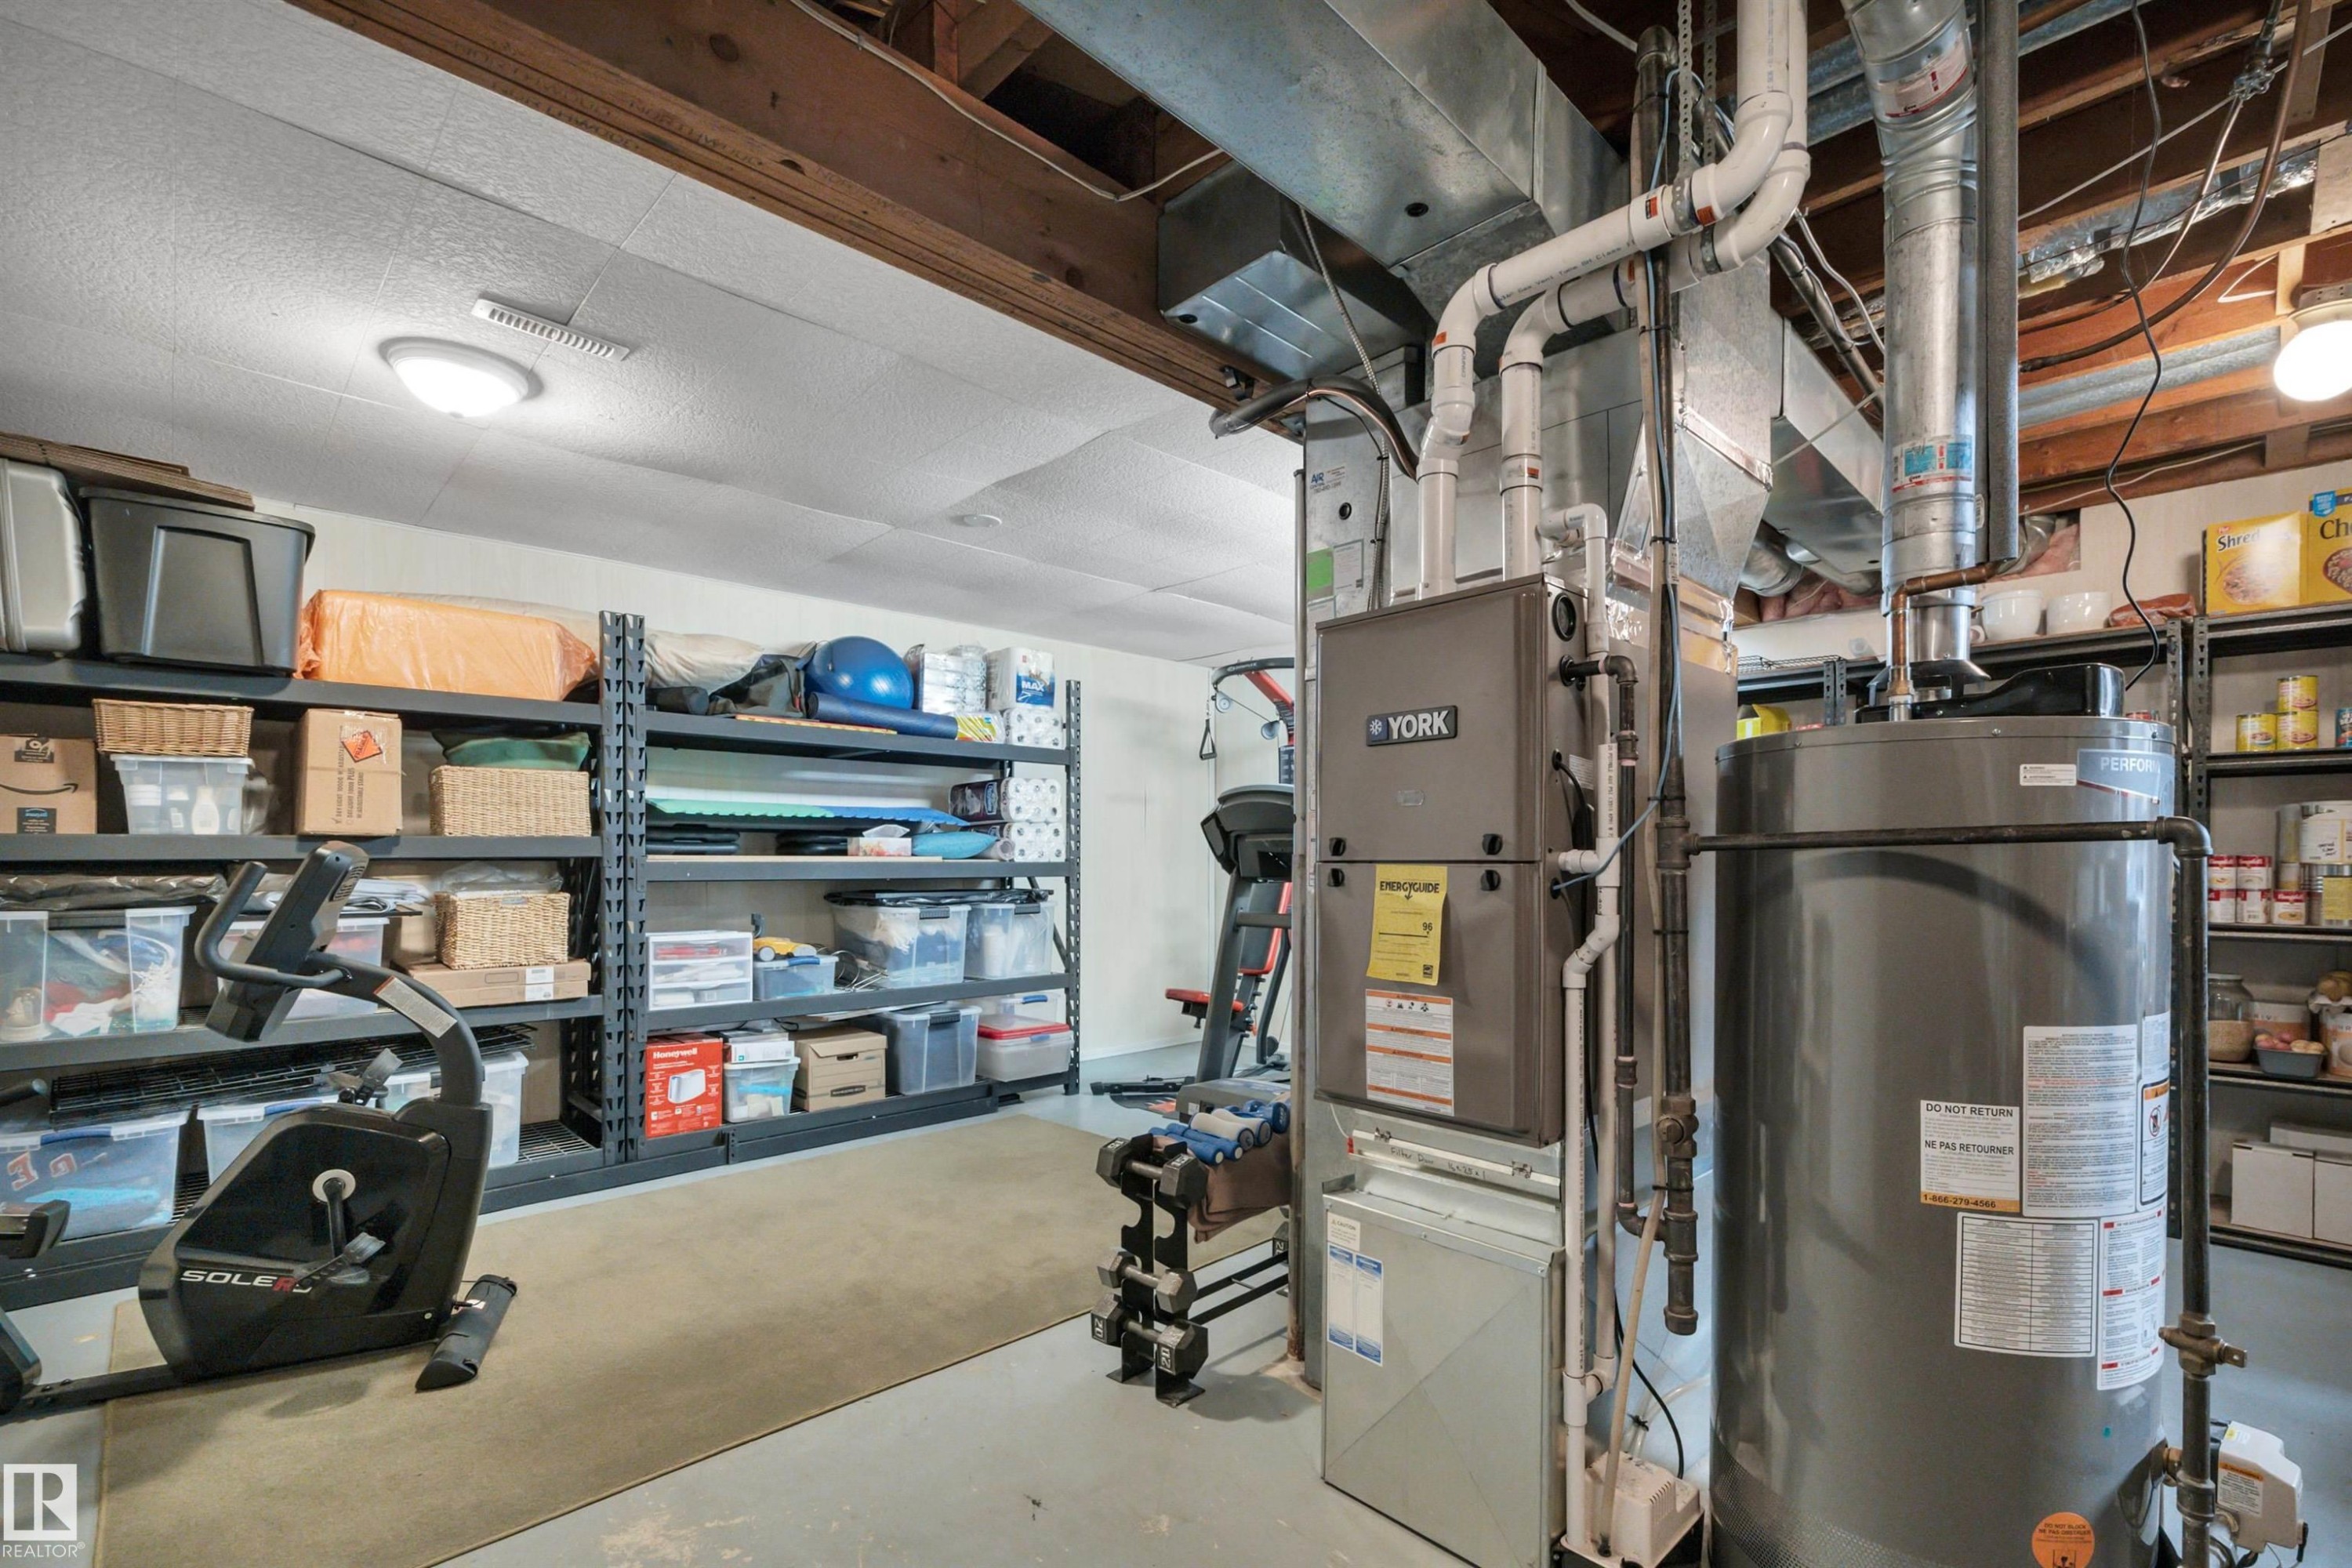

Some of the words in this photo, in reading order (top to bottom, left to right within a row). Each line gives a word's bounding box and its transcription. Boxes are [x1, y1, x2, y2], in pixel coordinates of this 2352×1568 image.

[1311, 472, 1324, 484] AIR
[1022, 681, 1044, 691] MAX
[1388, 710, 1449, 739] YORK
[1380, 880, 1440, 894] ENERGYGUIDE
[1422, 922, 1433, 931] 96
[653, 1047, 698, 1059] Honeywell
[1926, 1103, 1942, 1112] DO
[1944, 1105, 1966, 1114] NOT
[1970, 1106, 2013, 1117] RETURN
[1391, 1147, 1411, 1159] Filter
[1925, 1140, 1936, 1149] NE
[1939, 1142, 1957, 1151] PAS
[1959, 1143, 2014, 1155] RETOURNER
[1171, 1156, 1189, 1167] 15
[1923, 1194, 1996, 1208] 1-866-279-4566
[1337, 1221, 1356, 1231] CAUTION
[180, 1270, 277, 1287] SOLE
[1094, 1319, 1104, 1338] 20
[1160, 1347, 1171, 1368] 20
